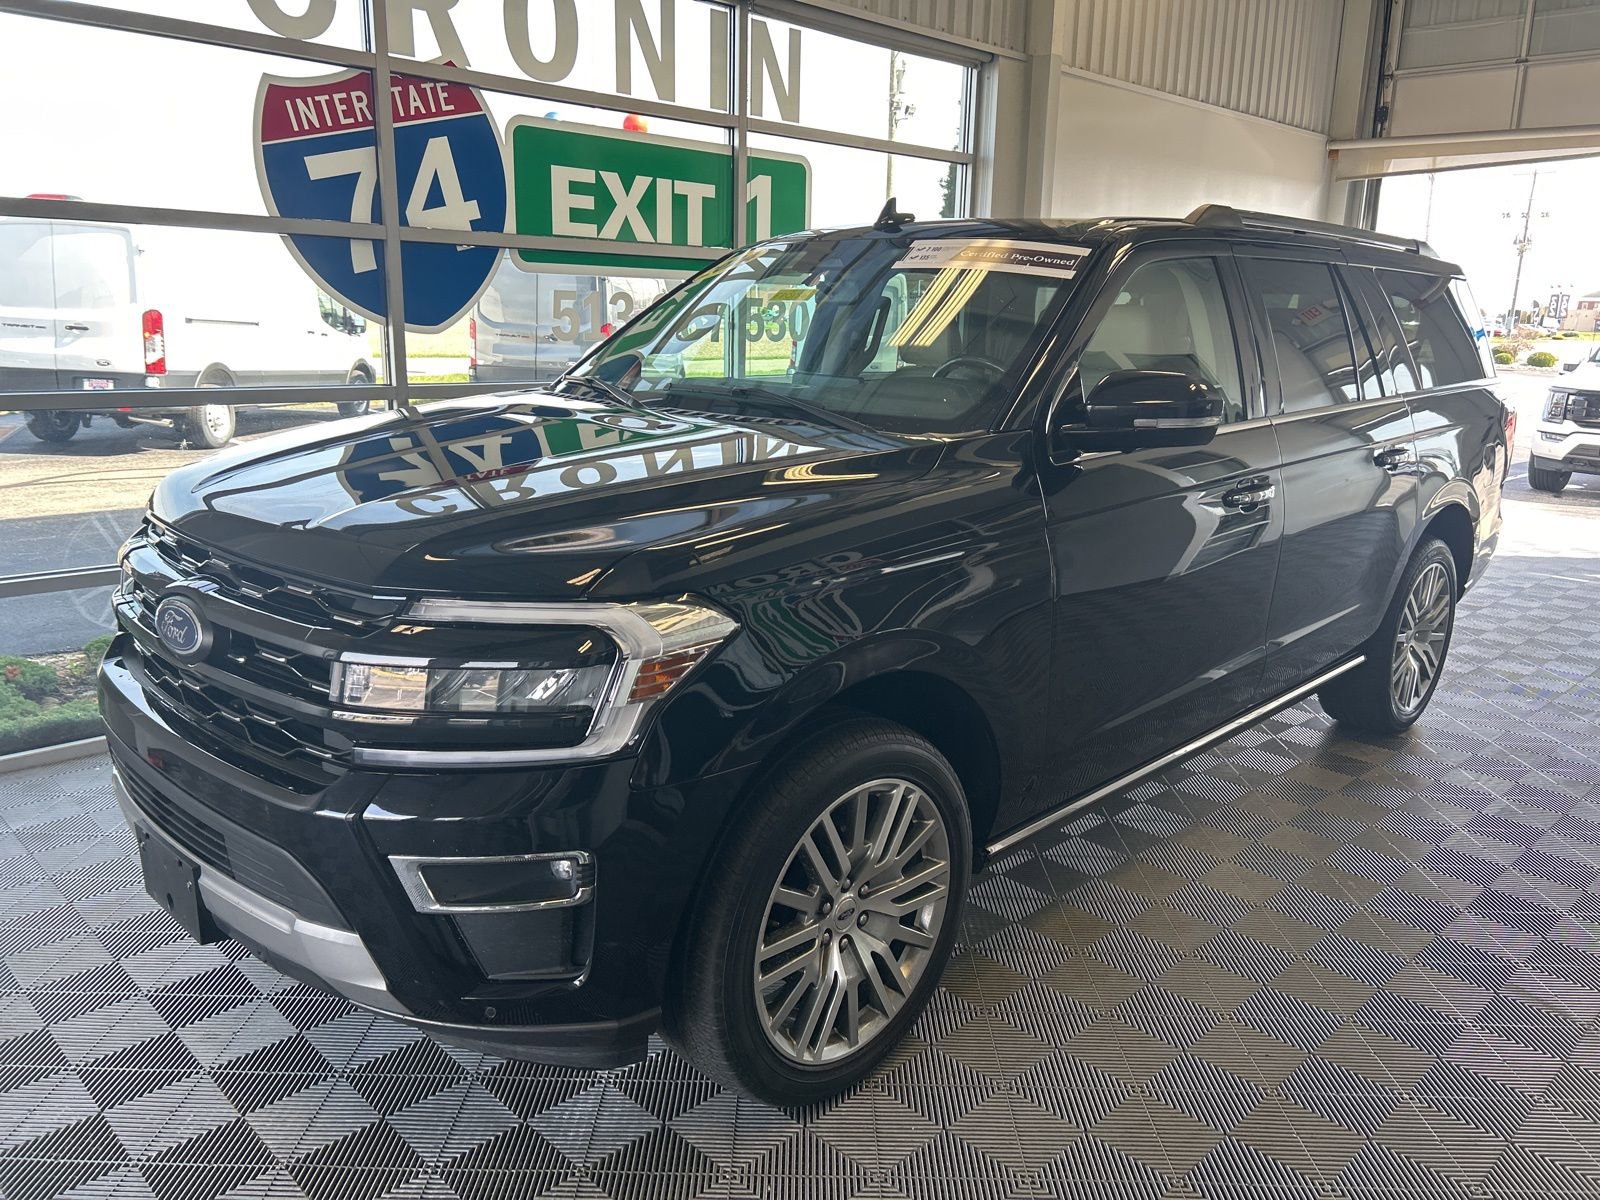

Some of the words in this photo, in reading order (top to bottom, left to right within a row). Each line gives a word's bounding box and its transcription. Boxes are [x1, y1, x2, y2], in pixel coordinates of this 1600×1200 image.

[285, 81, 456, 132] INTERTATE
[303, 135, 484, 274] 74
[550, 164, 716, 247] EXIT
[745, 174, 773, 246] 1
[1011, 252, 1076, 267] Pre-Owned
[552, 289, 634, 342] 513
[161, 609, 189, 644] Ford
